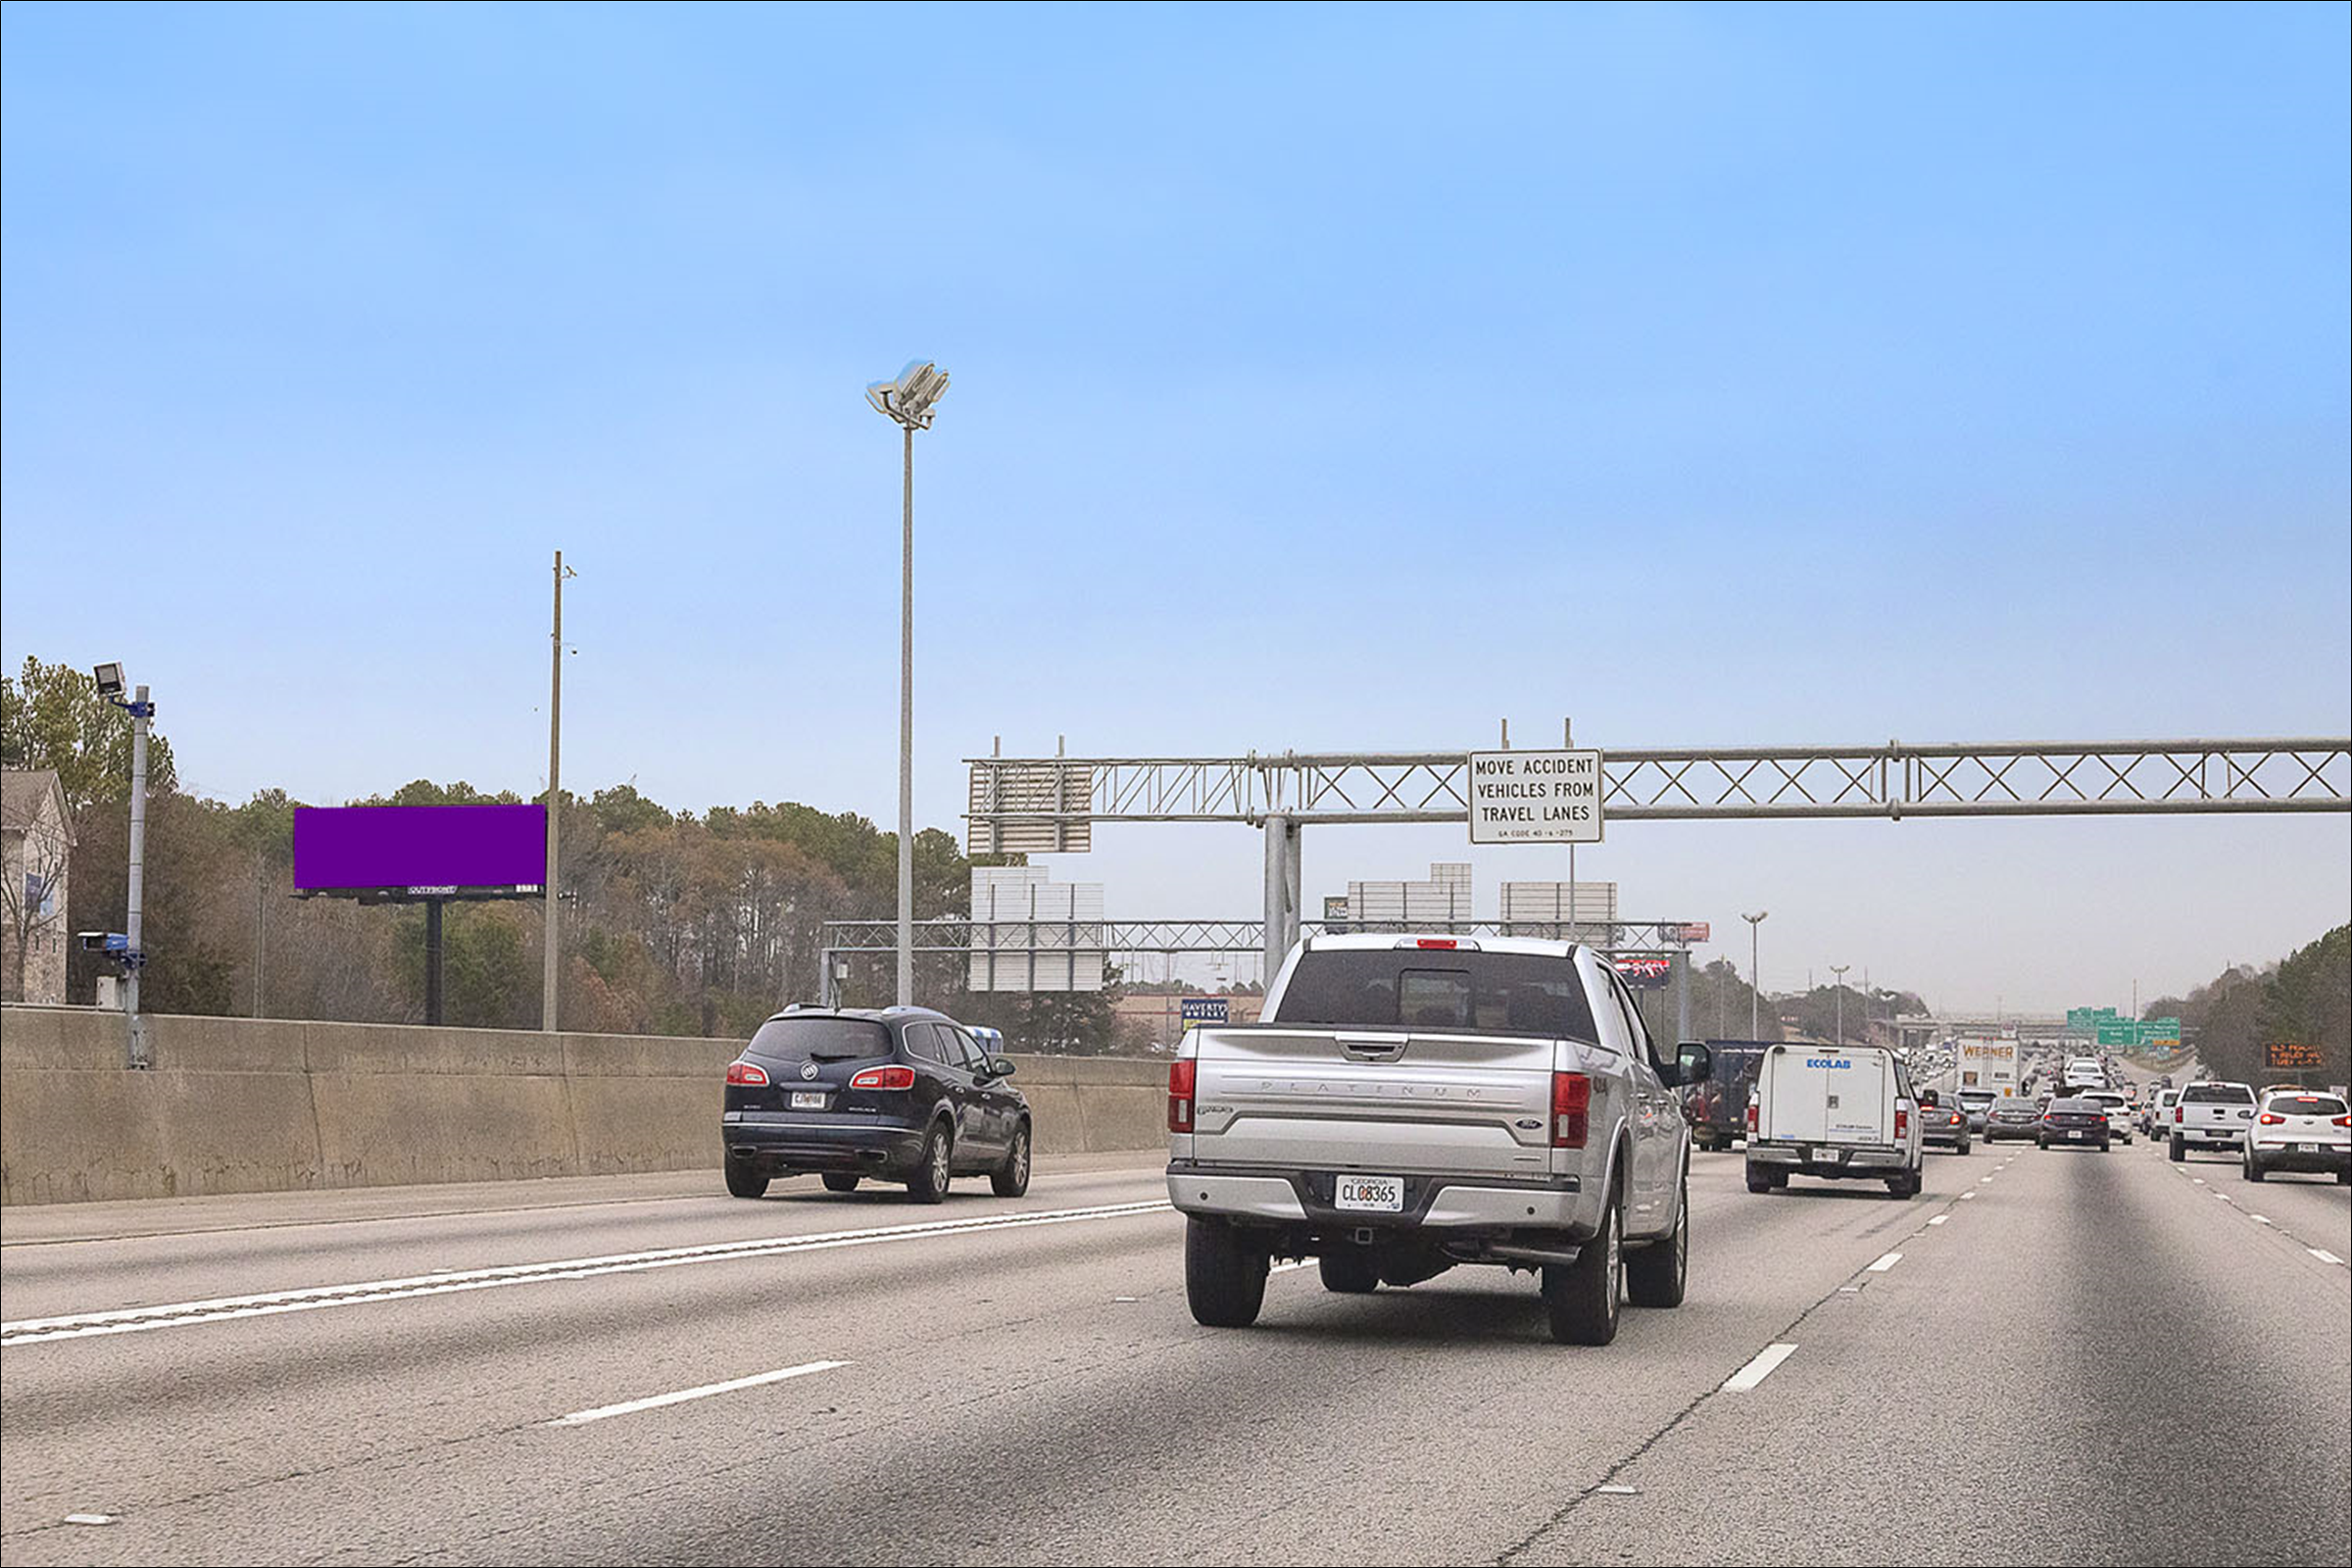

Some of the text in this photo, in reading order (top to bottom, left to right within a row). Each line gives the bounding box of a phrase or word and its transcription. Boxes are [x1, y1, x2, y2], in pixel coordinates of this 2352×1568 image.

[1476, 759, 1593, 775] MOVE ACCIDENT
[1478, 782, 1593, 799] VEHICLES FROM
[1482, 805, 1590, 821] TRAVEL LANES
[1963, 1044, 2014, 1058] WERNER
[1806, 1058, 1851, 1069] ECOLAB
[1260, 1081, 1482, 1098] PLATINUM
